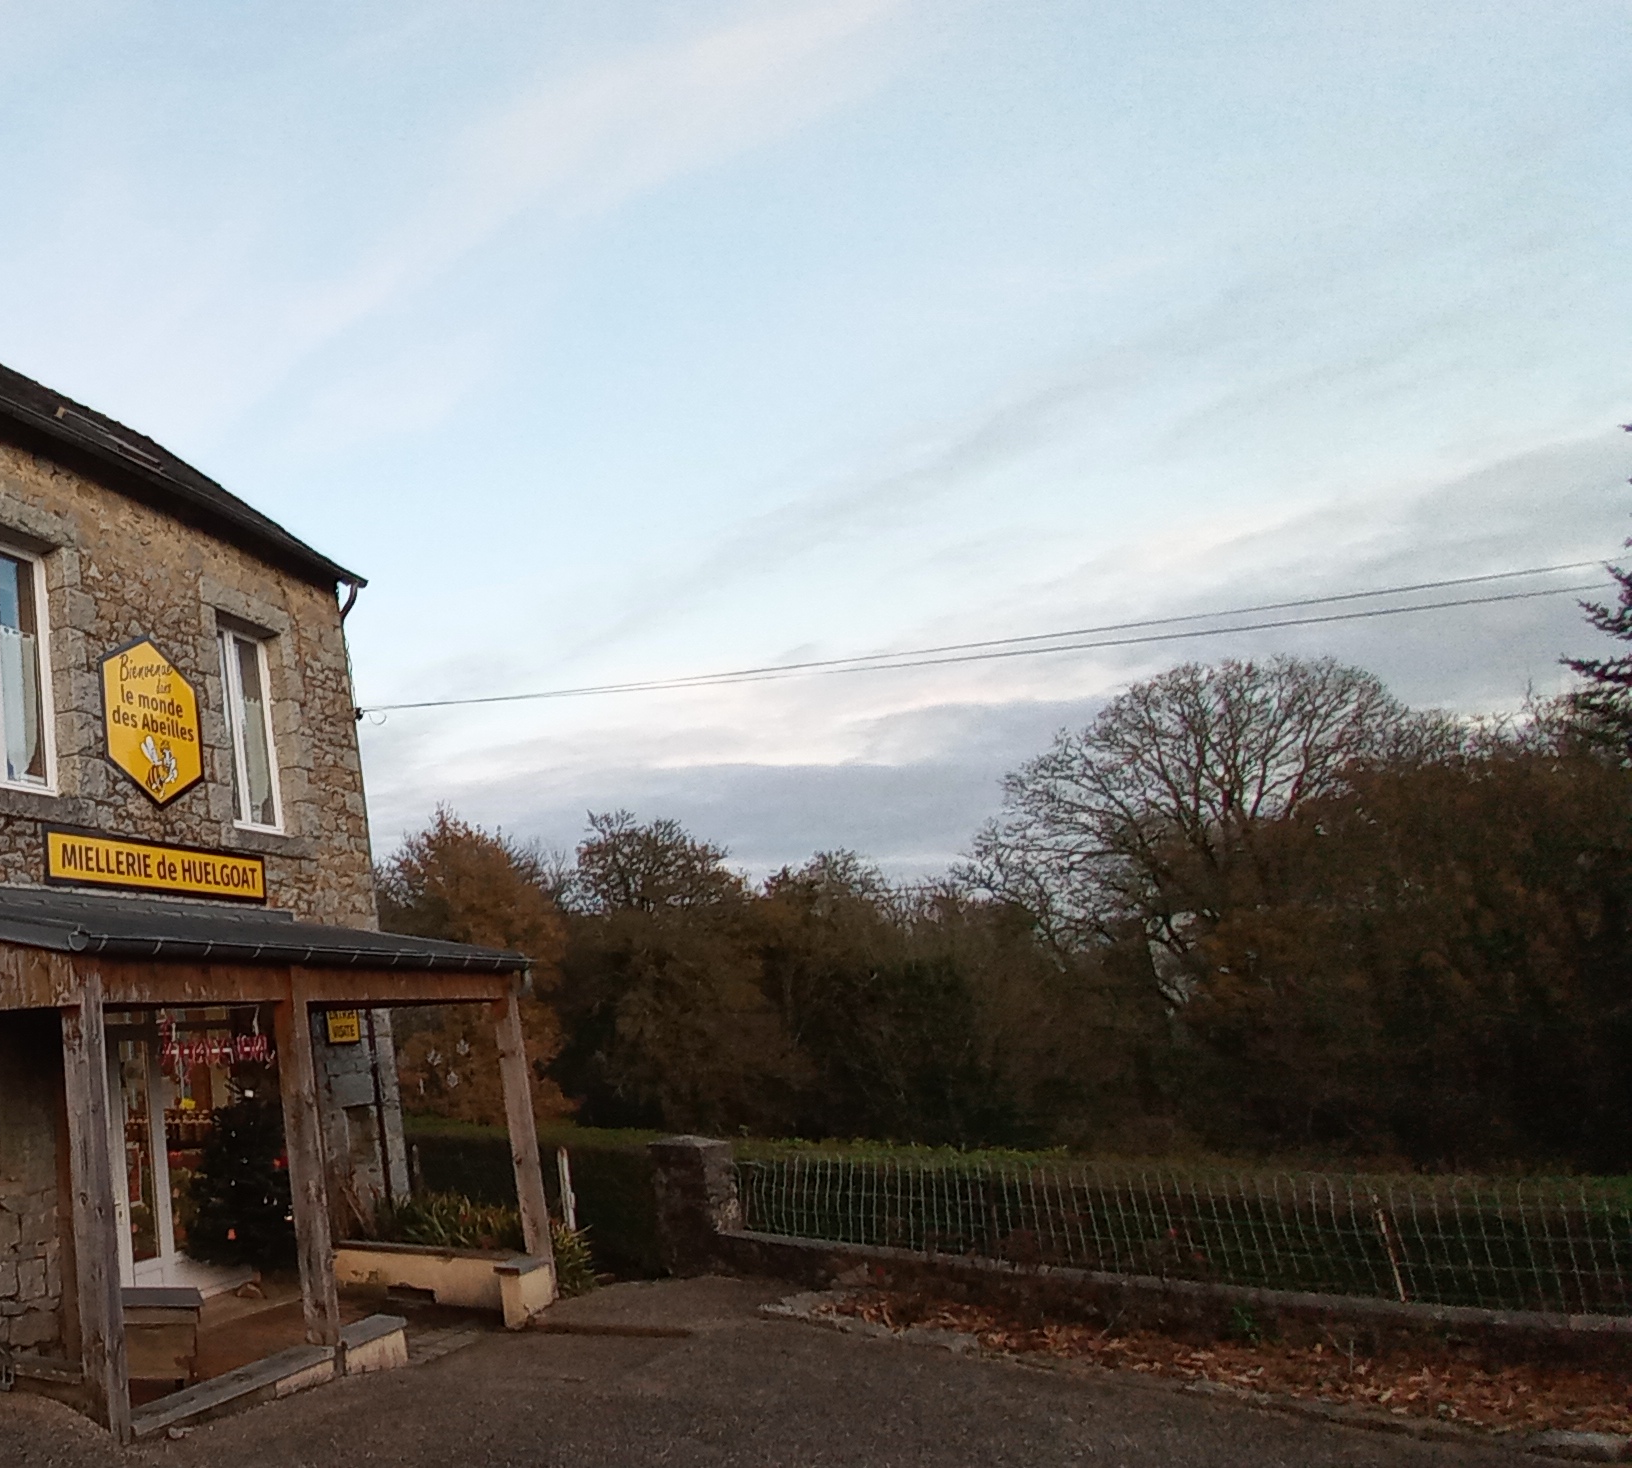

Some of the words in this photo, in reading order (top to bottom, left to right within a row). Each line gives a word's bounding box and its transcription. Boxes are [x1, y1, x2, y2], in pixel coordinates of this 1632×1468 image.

[121, 684, 134, 705] le
[138, 693, 184, 719] monde
[112, 705, 138, 729] des
[141, 713, 195, 743] Abeilles
[61, 842, 153, 879] MIELLERIE
[156, 854, 177, 882] de
[180, 858, 258, 890] HUELGOAT
